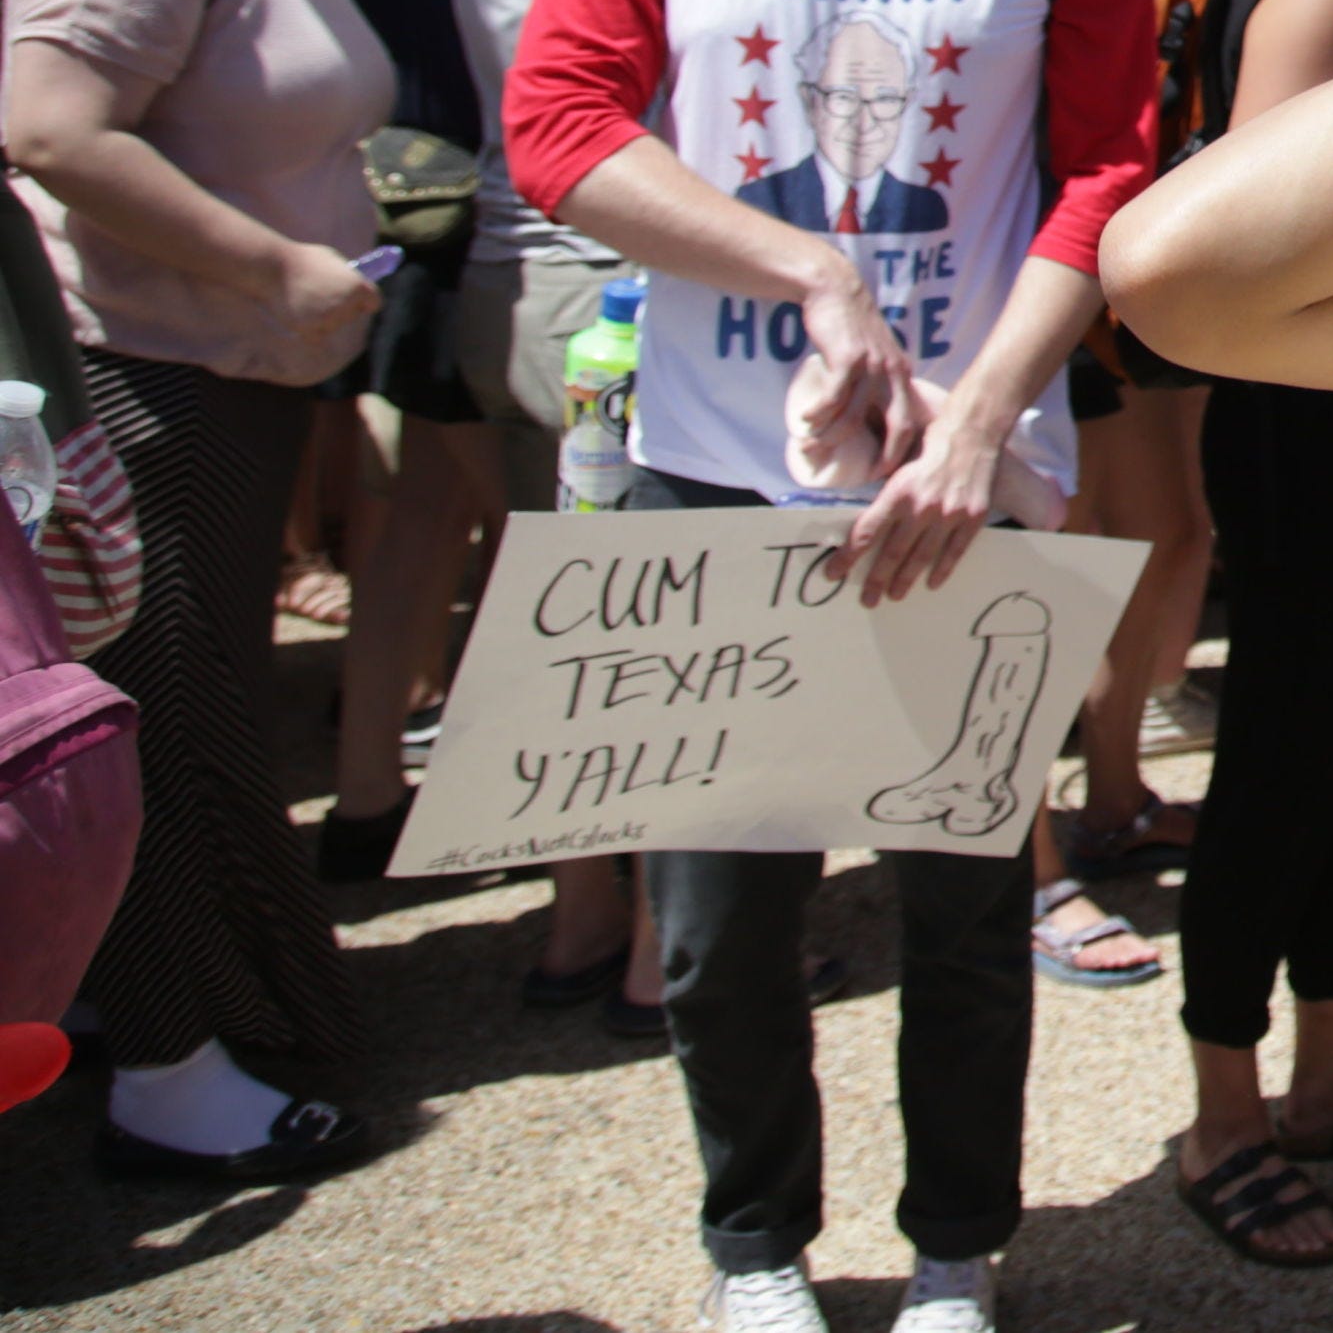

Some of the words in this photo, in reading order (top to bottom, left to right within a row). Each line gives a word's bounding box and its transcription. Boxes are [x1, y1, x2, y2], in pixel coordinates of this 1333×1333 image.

[873, 242, 956, 286] THE
[533, 549, 711, 638] CUM
[763, 543, 848, 608] TO
[549, 635, 799, 720] TEXAS,
